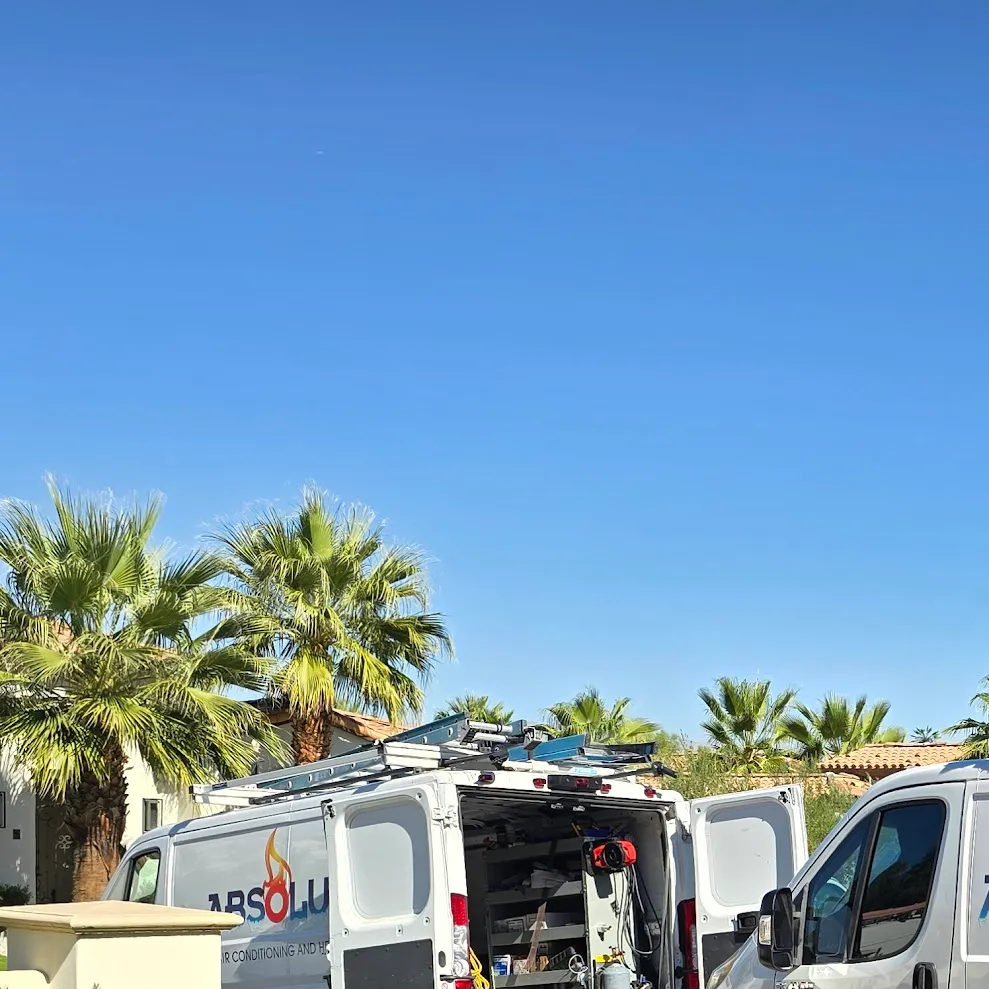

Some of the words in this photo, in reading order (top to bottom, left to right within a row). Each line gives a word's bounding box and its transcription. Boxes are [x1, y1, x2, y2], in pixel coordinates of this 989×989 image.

[208, 877, 329, 924] ABSOLU
[221, 951, 230, 963] IR
[231, 944, 296, 963] CONDITIONING
[297, 942, 316, 955] AND
